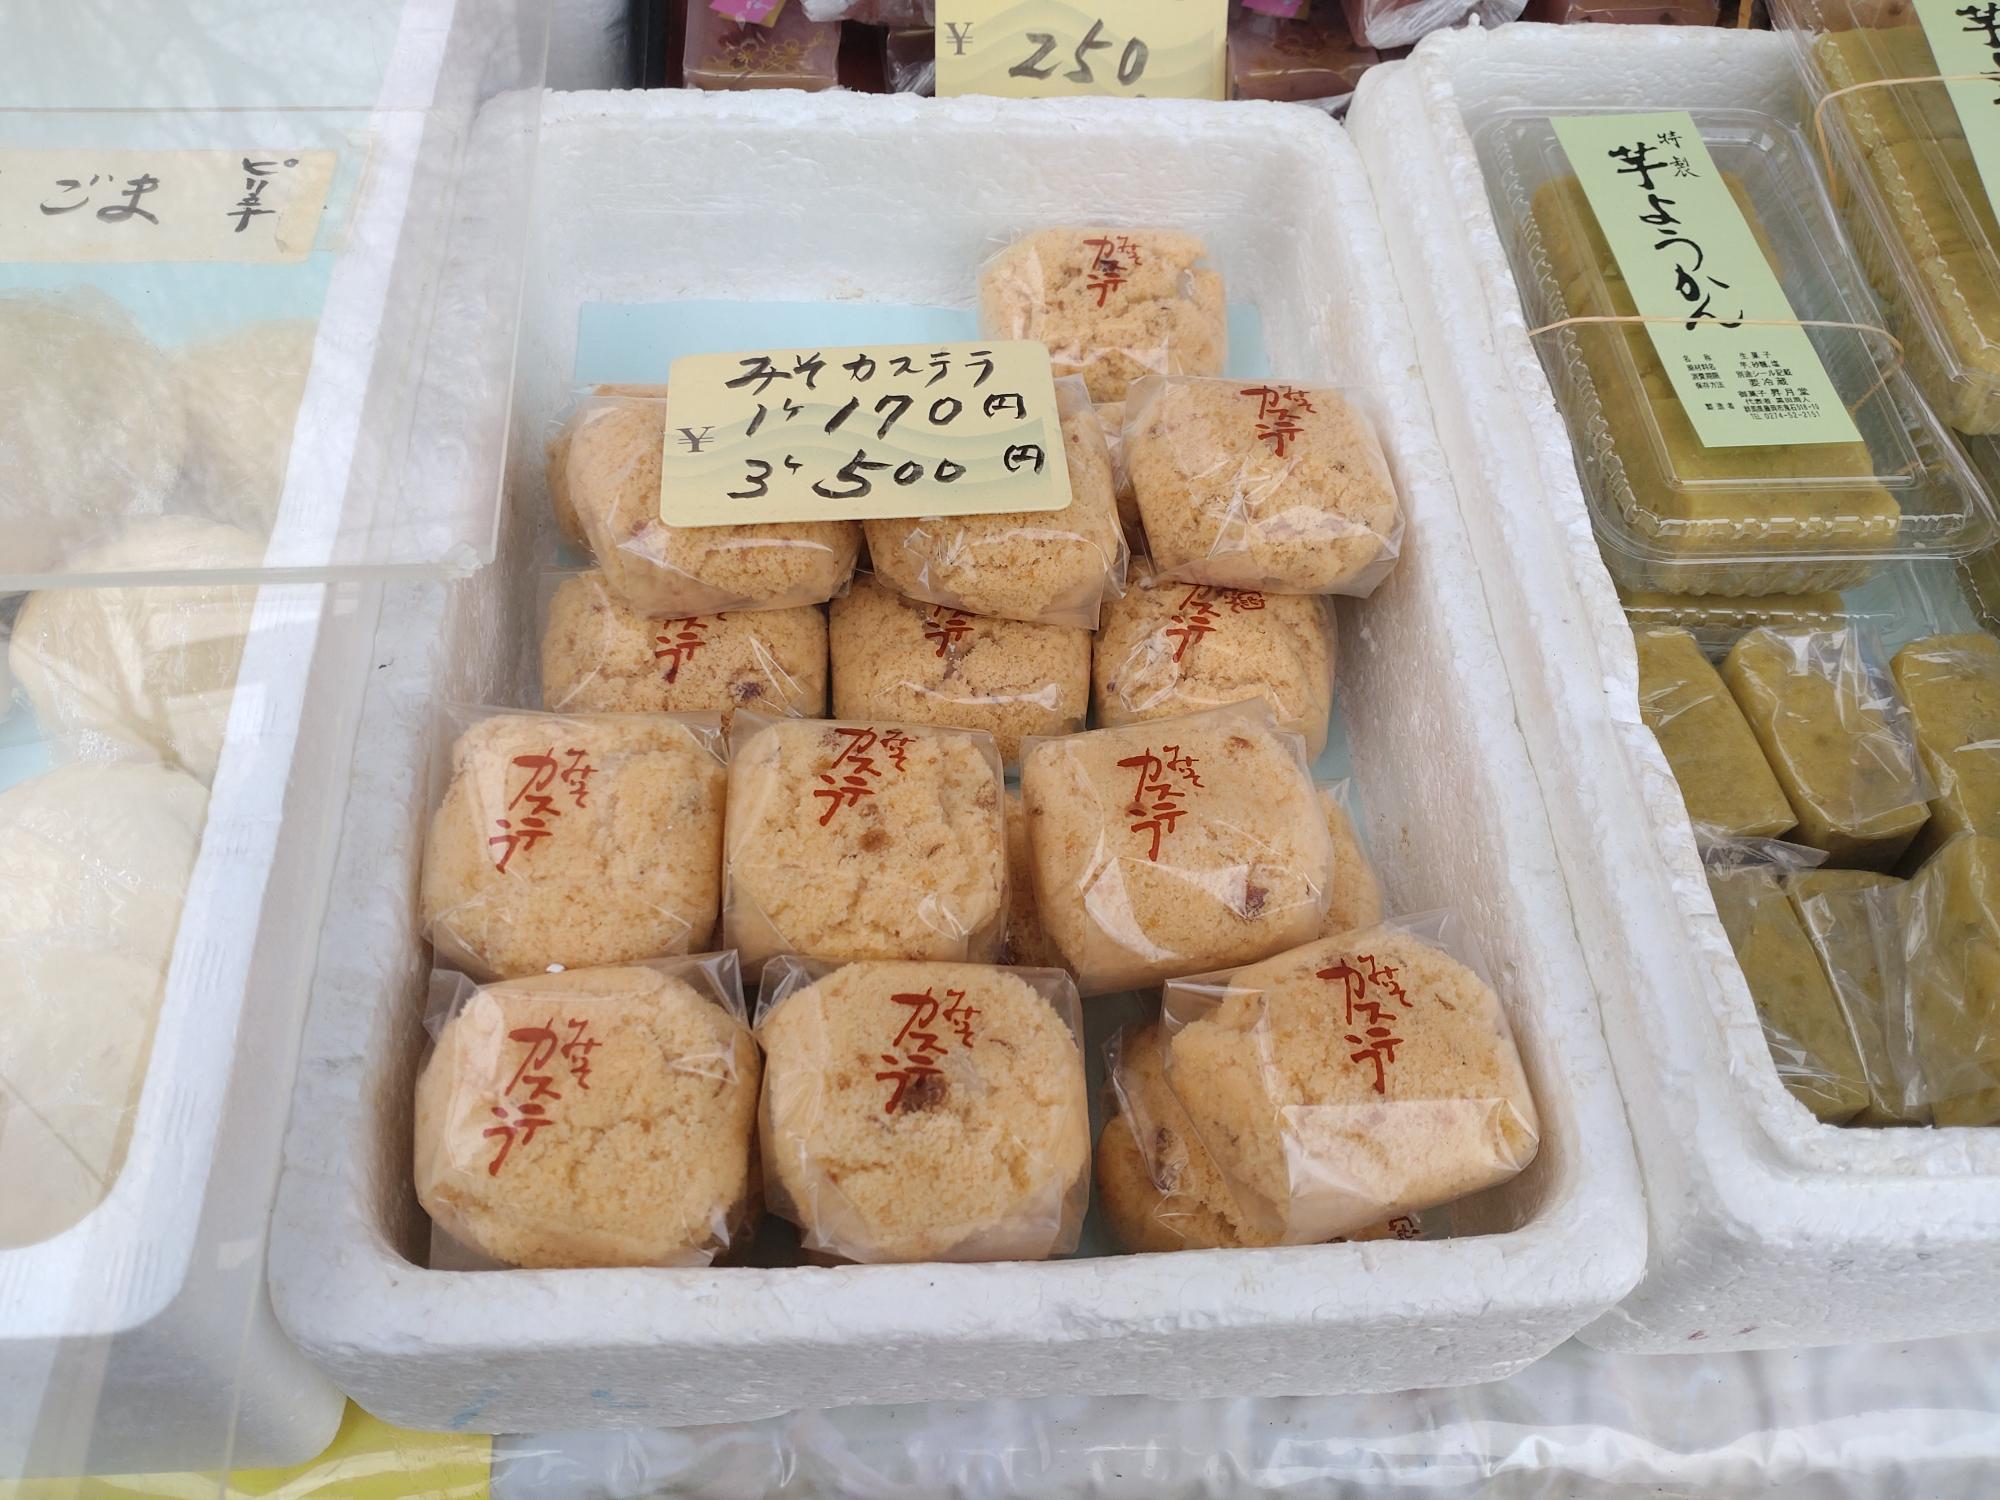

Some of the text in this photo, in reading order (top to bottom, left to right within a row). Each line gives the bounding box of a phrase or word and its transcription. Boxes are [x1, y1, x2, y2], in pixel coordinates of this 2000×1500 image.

[1008, 18, 1149, 86] 250
[1657, 130, 1700, 178] 特製
[40, 173, 159, 225] ごま
[1608, 142, 1744, 331] 芋ようかん
[1083, 235, 1128, 308] カステラ
[725, 351, 993, 396] みそカステラ
[1240, 385, 1304, 457] カステラ
[654, 617, 708, 684] ステラ
[489, 747, 561, 873] カステラ
[813, 727, 882, 826] カステラ
[1117, 747, 1188, 862] カステラ
[875, 986, 948, 1114] カステラ
[1316, 958, 1404, 1094] カステラ
[483, 1017, 562, 1176] カステラ
